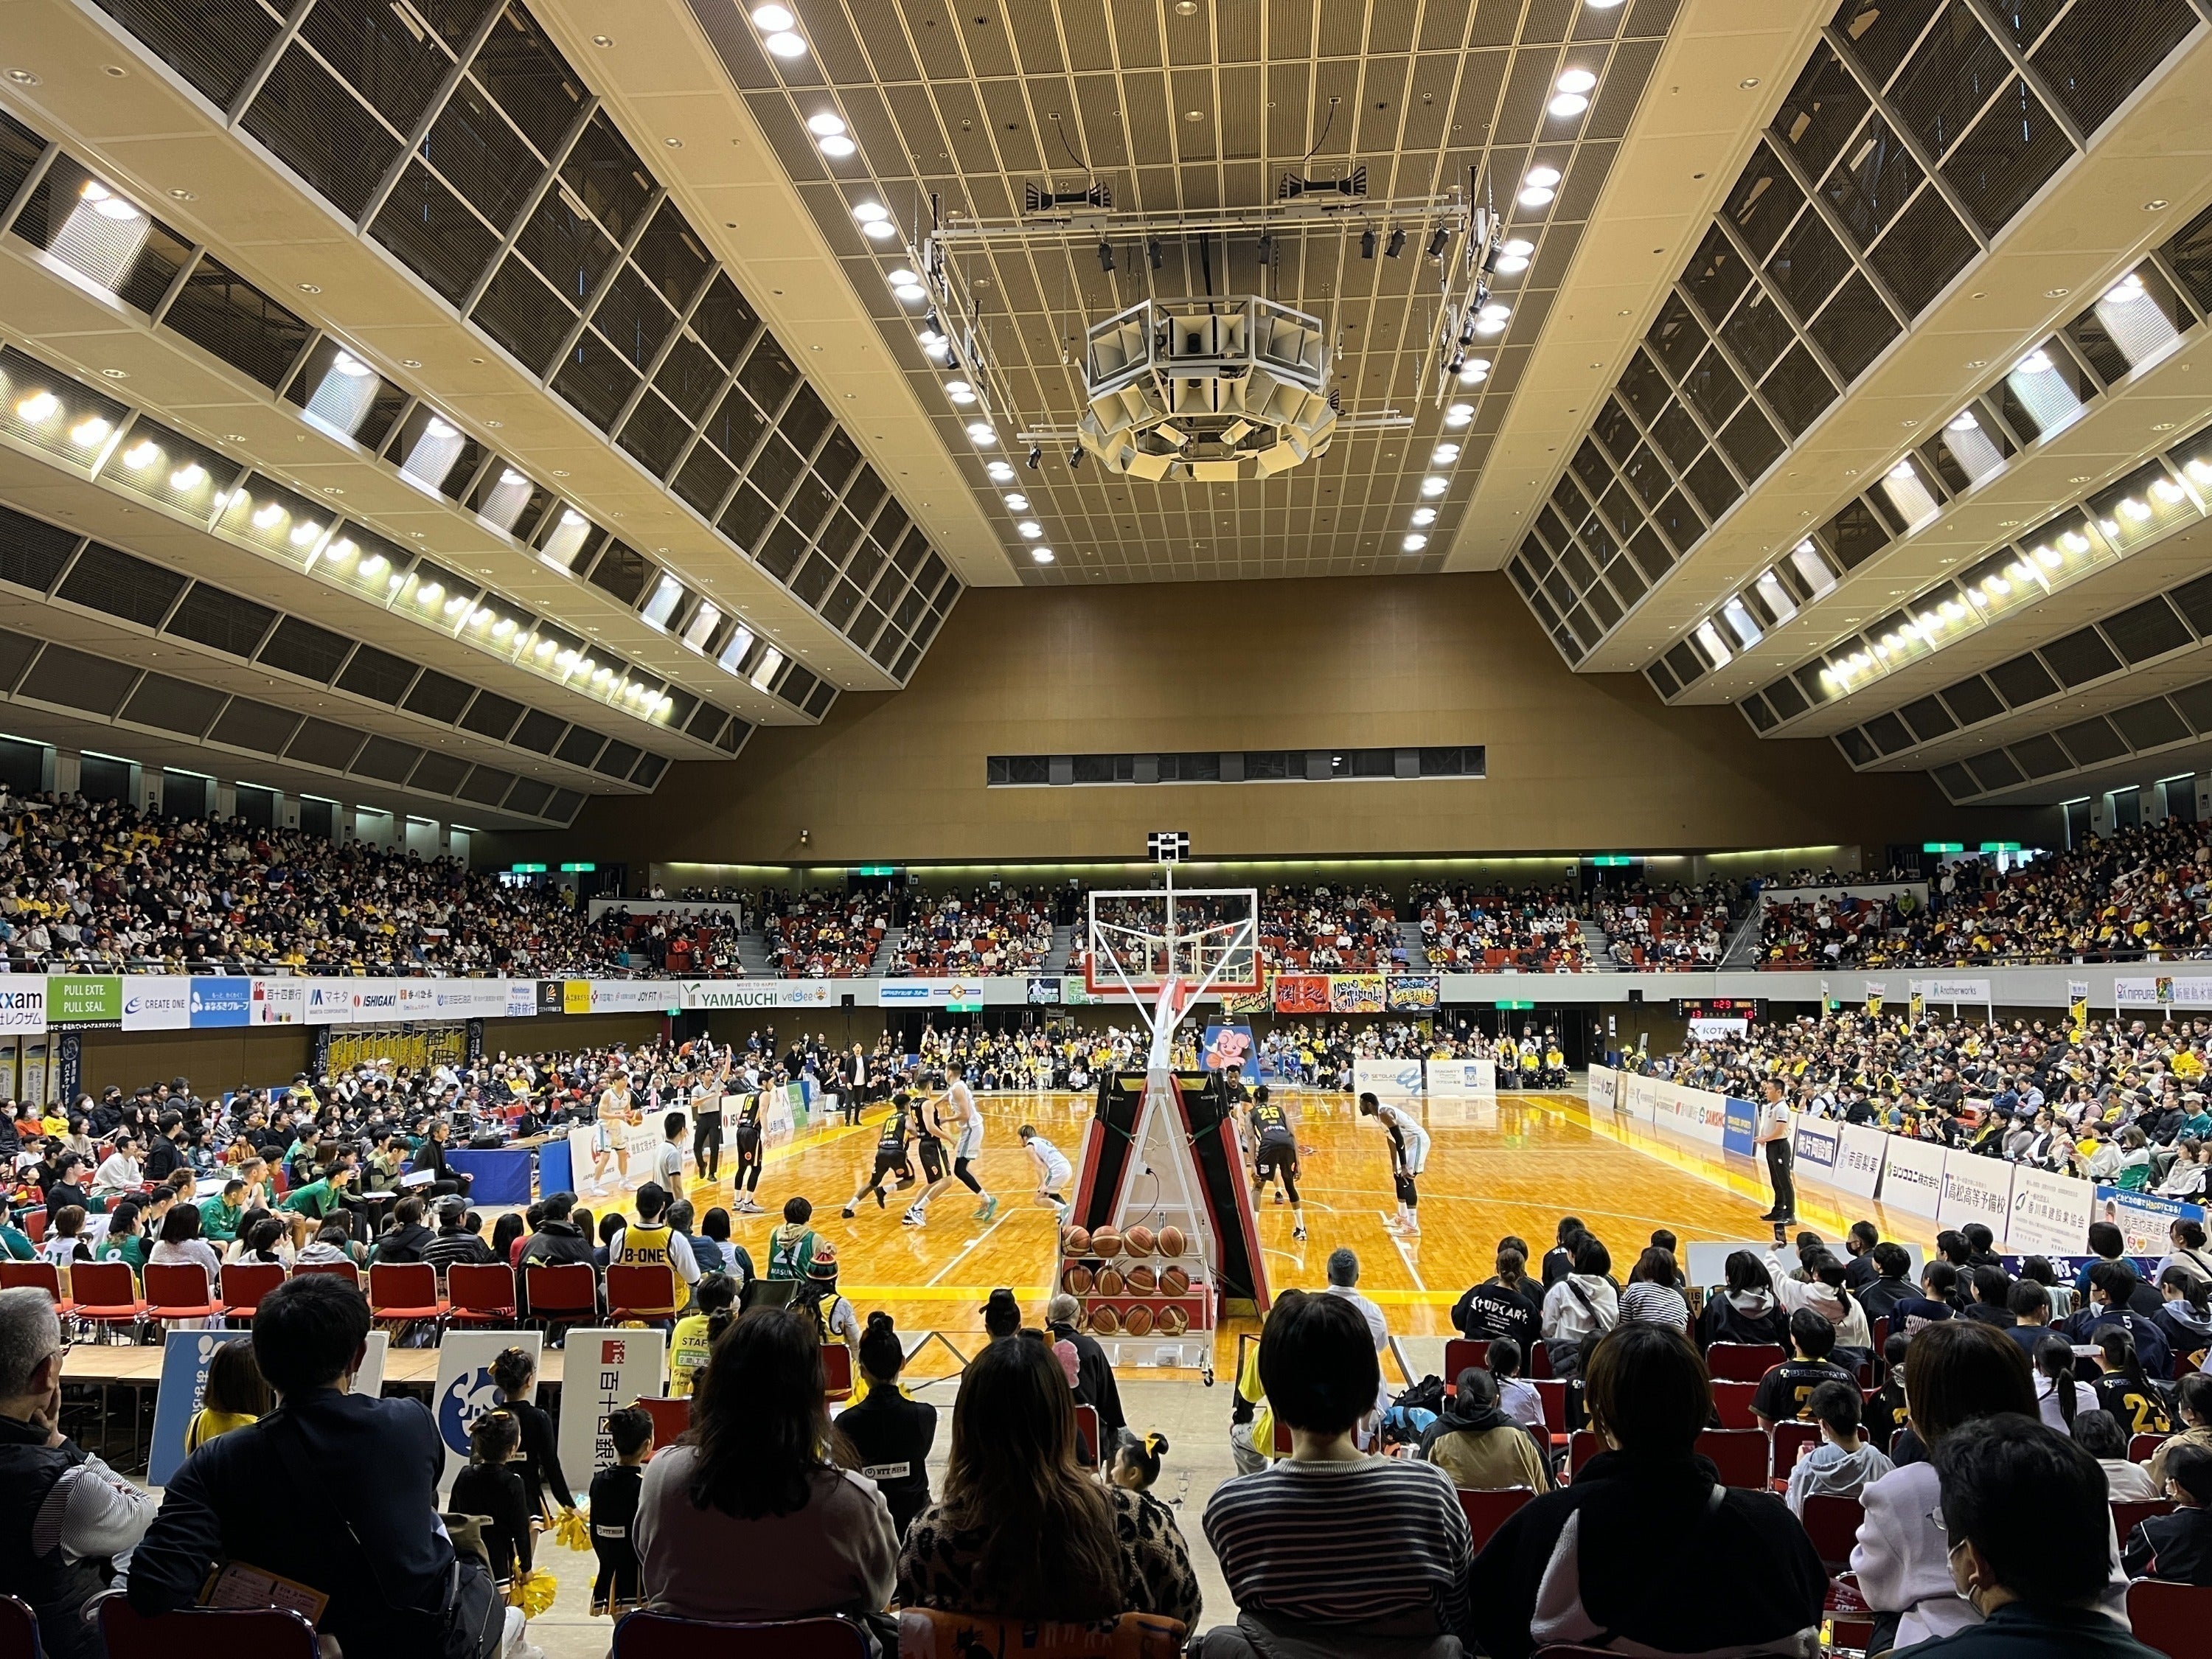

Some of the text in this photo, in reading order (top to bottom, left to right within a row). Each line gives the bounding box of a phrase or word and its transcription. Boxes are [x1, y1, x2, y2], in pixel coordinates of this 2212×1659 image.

[64, 984, 106, 995] PULL EXTE.
[267, 989, 302, 1000] 百十四銀行
[1941, 985, 1977, 995] Anotherworks
[325, 991, 348, 1003] マキタ
[363, 995, 396, 1006] ISHIGAKI
[638, 992, 648, 1001] JOY
[649, 992, 657, 1001] FIT
[701, 993, 777, 1006] YAMAUCHI
[63, 1001, 105, 1012] PULL SEAL.
[145, 999, 185, 1009] CREATE ONE
[204, 1001, 249, 1011] あなぶきグループ
[1713, 1000, 1731, 1009] 1:29
[743, 1093, 754, 1111] 16
[1258, 1107, 1280, 1120] 25
[884, 1119, 898, 1133] 19
[1948, 1183, 2006, 1215] 高松高等予備校
[625, 1248, 665, 1262] B-ONE
[2122, 1316, 2132, 1329] 5
